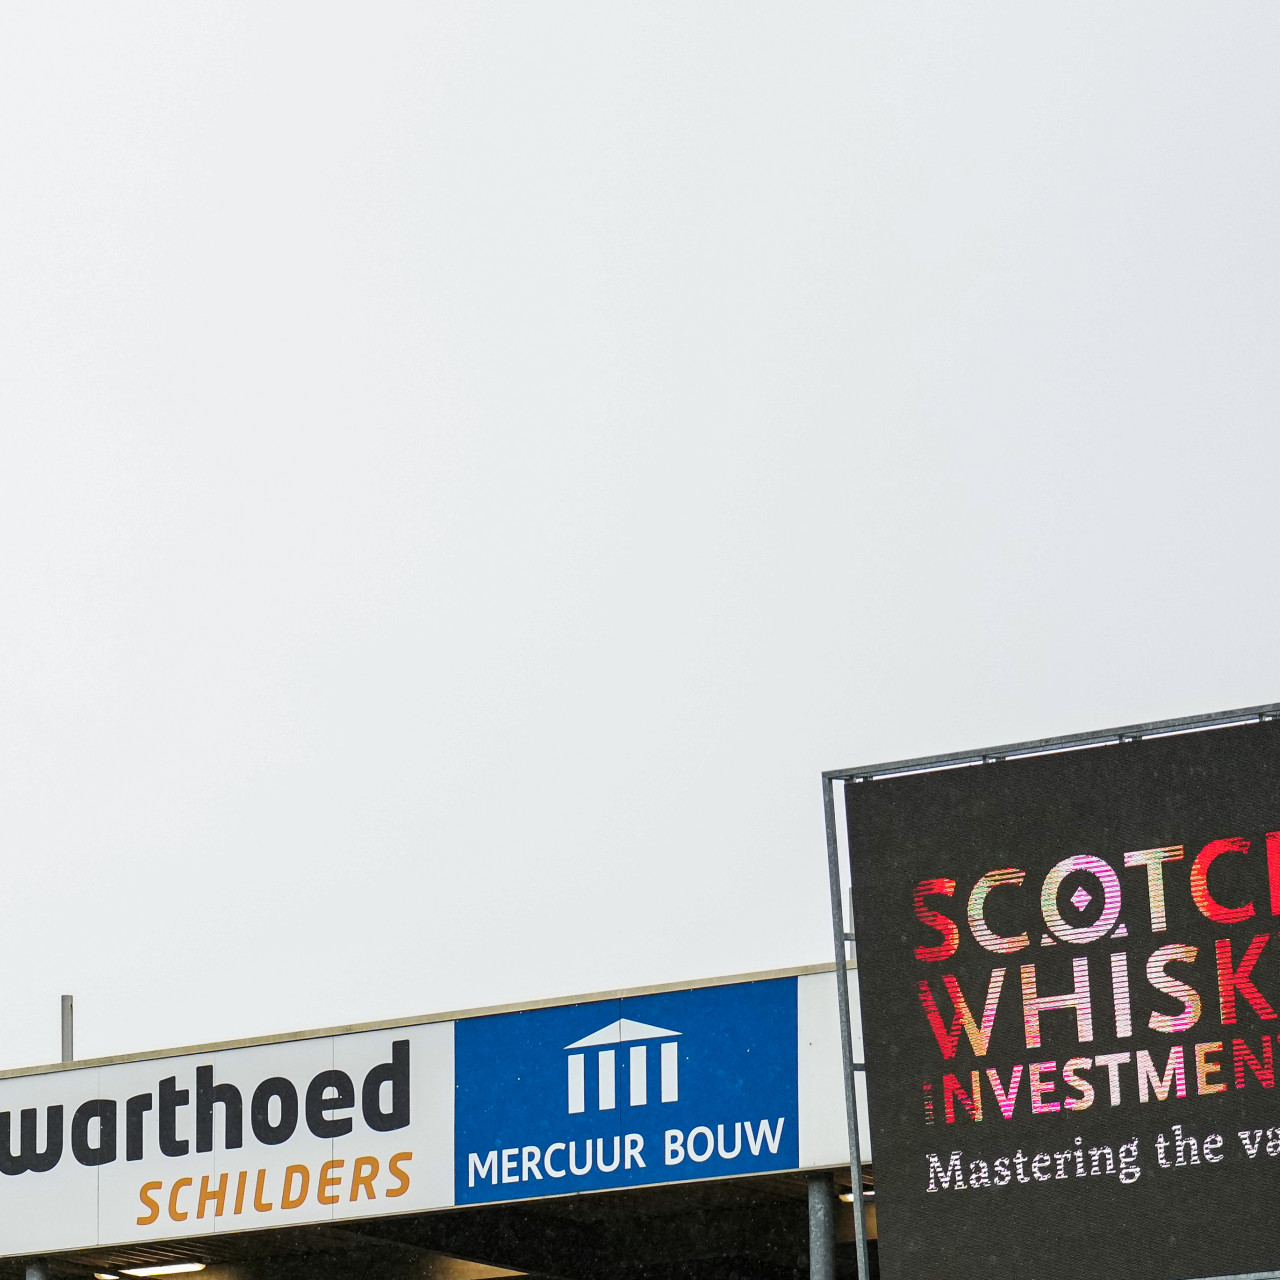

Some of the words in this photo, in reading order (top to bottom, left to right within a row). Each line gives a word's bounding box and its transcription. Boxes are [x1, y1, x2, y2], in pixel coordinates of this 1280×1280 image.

[915, 936, 1280, 1060] WHISK
[924, 1033, 1280, 1127] INVESTMEN
[136, 1149, 413, 1227] SCHILDERS
[467, 1132, 646, 1187] MERCUUR
[664, 1116, 786, 1167] BOUW
[925, 1135, 1142, 1193] Mastering
[1155, 1124, 1225, 1168] the
